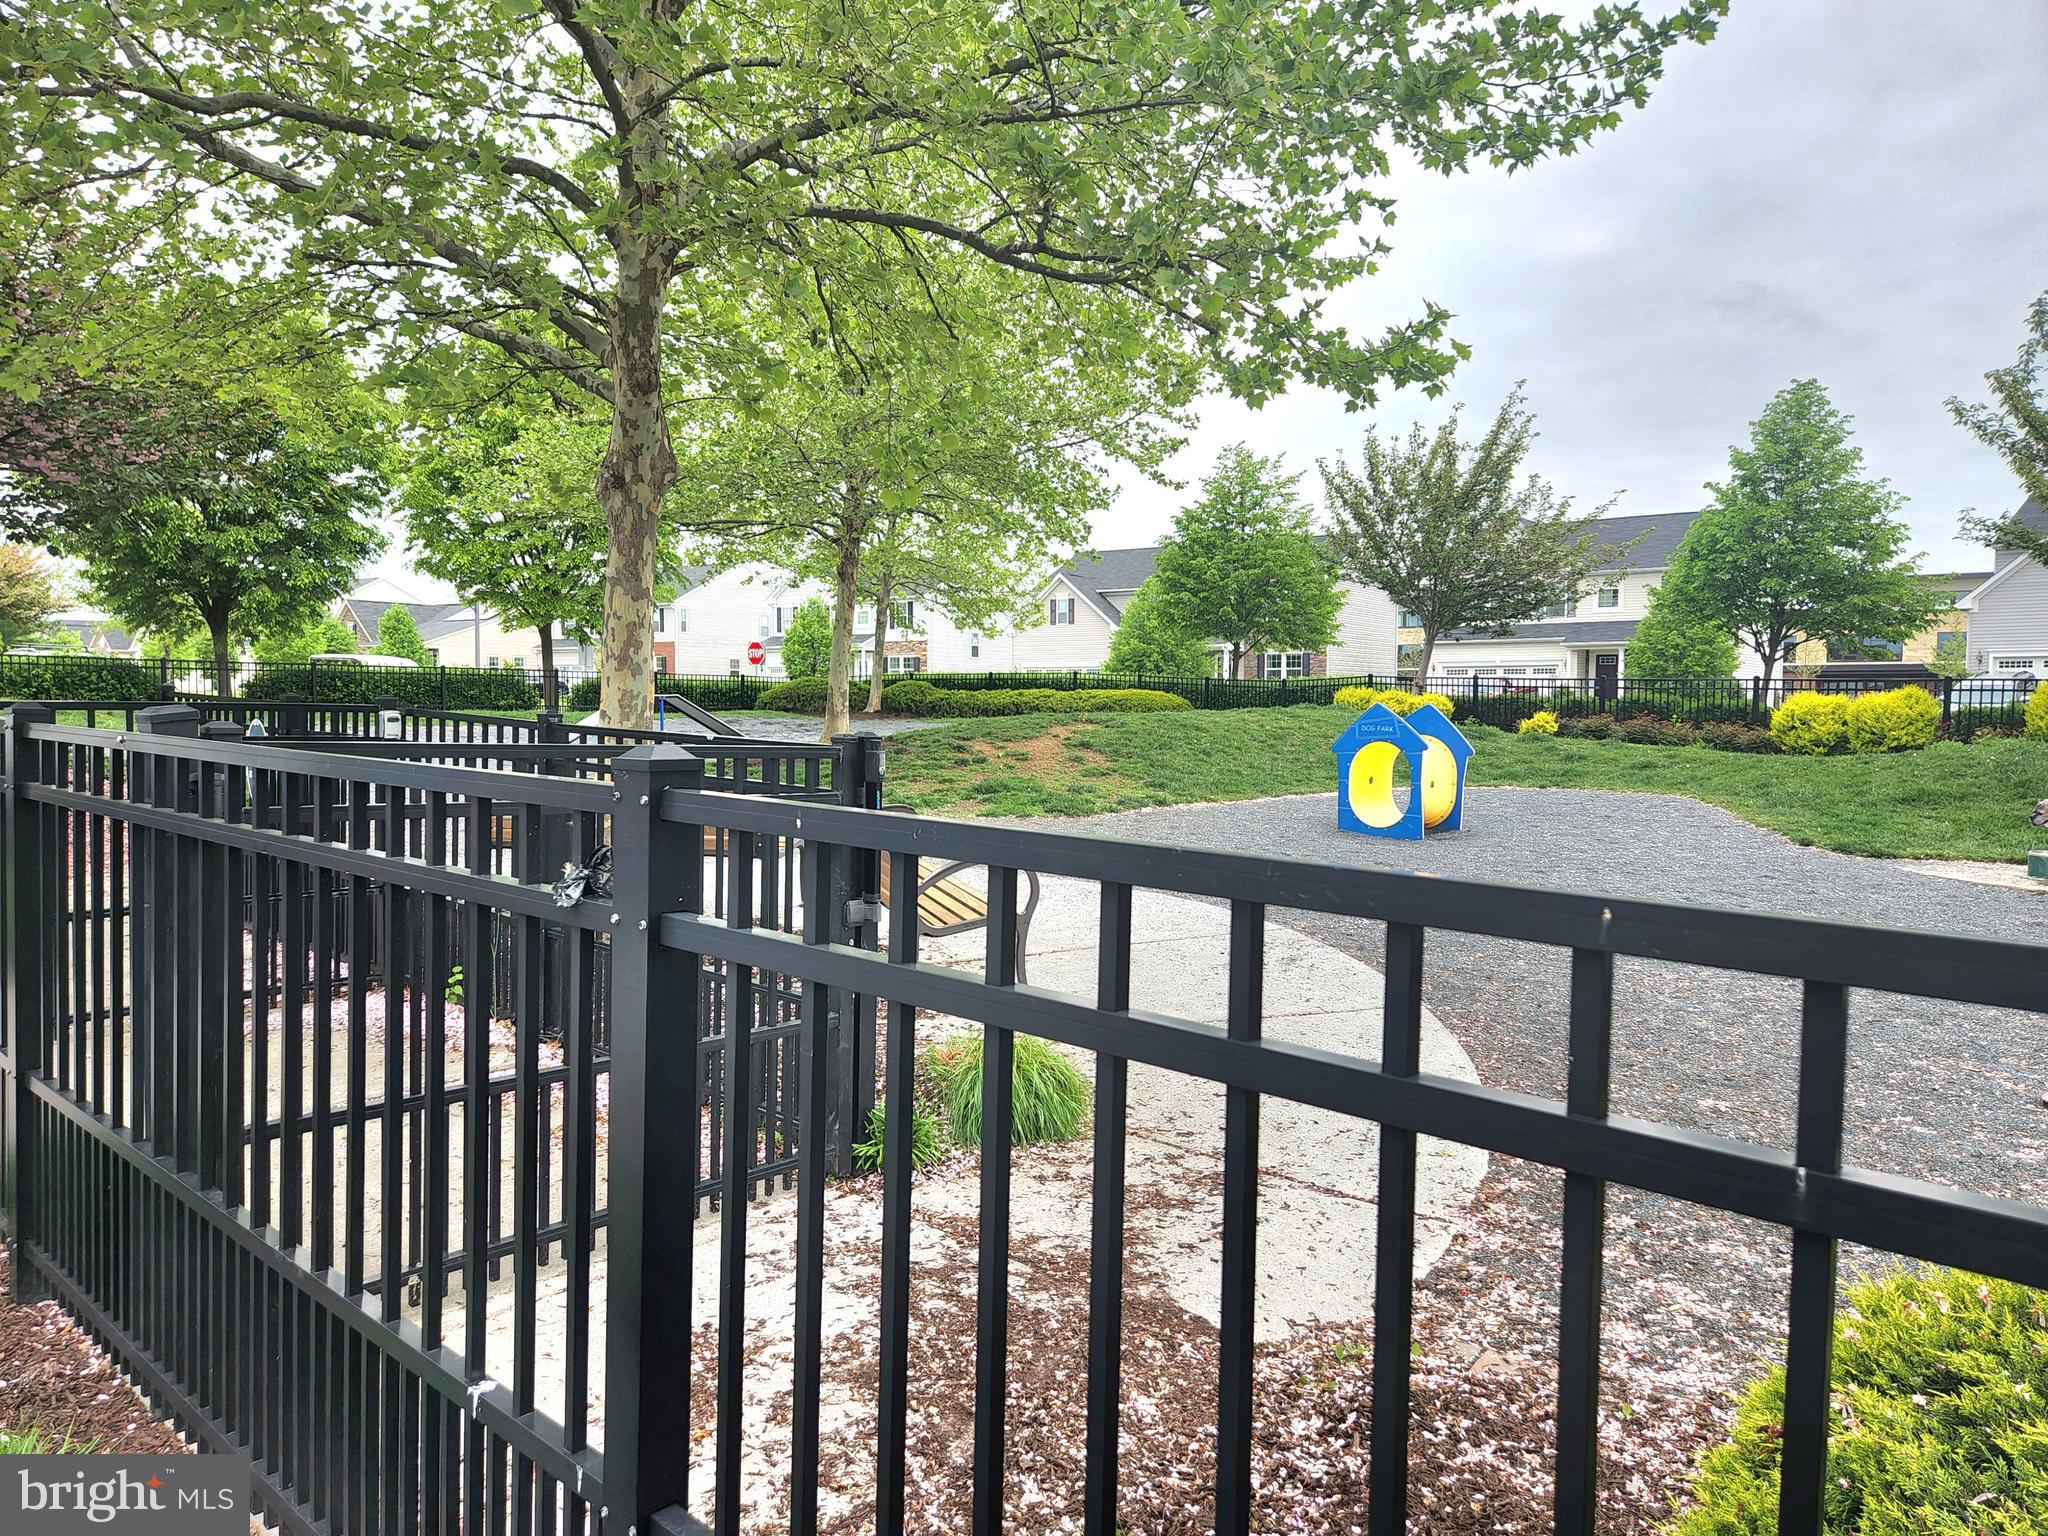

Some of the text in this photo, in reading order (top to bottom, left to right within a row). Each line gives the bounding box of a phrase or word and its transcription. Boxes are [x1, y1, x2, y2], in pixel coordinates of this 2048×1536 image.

[748, 648, 764, 658] STOP
[1361, 724, 1394, 733] DOG PARK
